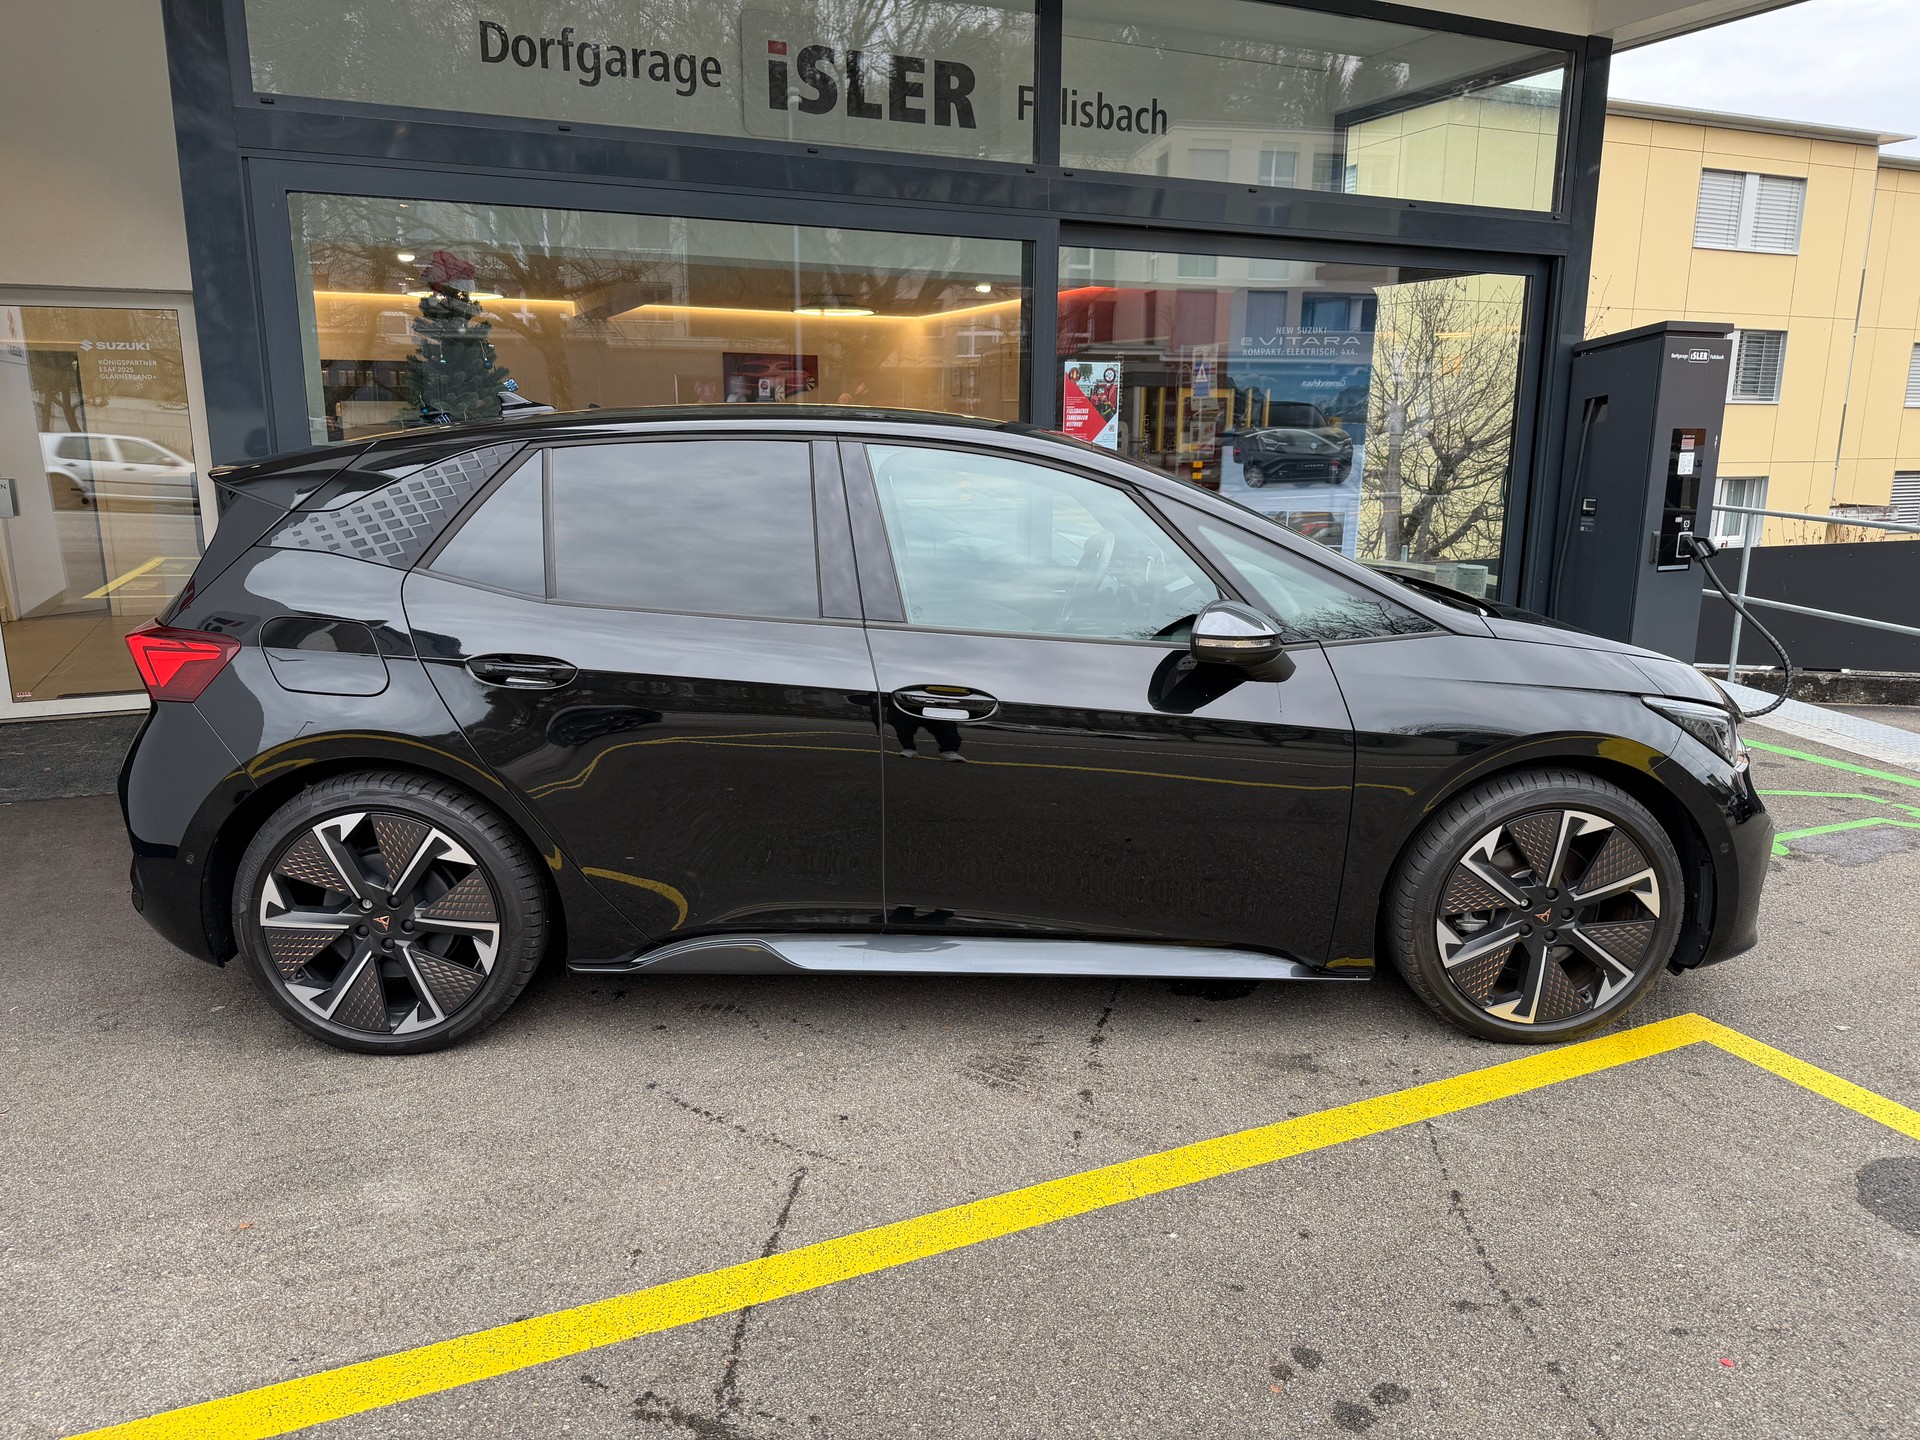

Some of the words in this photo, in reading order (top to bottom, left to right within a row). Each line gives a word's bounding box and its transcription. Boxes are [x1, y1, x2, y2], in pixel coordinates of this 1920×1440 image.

[479, 20, 722, 97] Dorfgarage
[1018, 84, 1168, 136] Flisbach
[1275, 326, 1294, 335] NEW
[1296, 326, 1327, 335] SUZUKI
[96, 341, 150, 351] SUZUKI
[1259, 336, 1361, 346] VITARA
[1242, 348, 1284, 356] KOMPAKT.
[1286, 348, 1338, 356] ELEKTRISCH.
